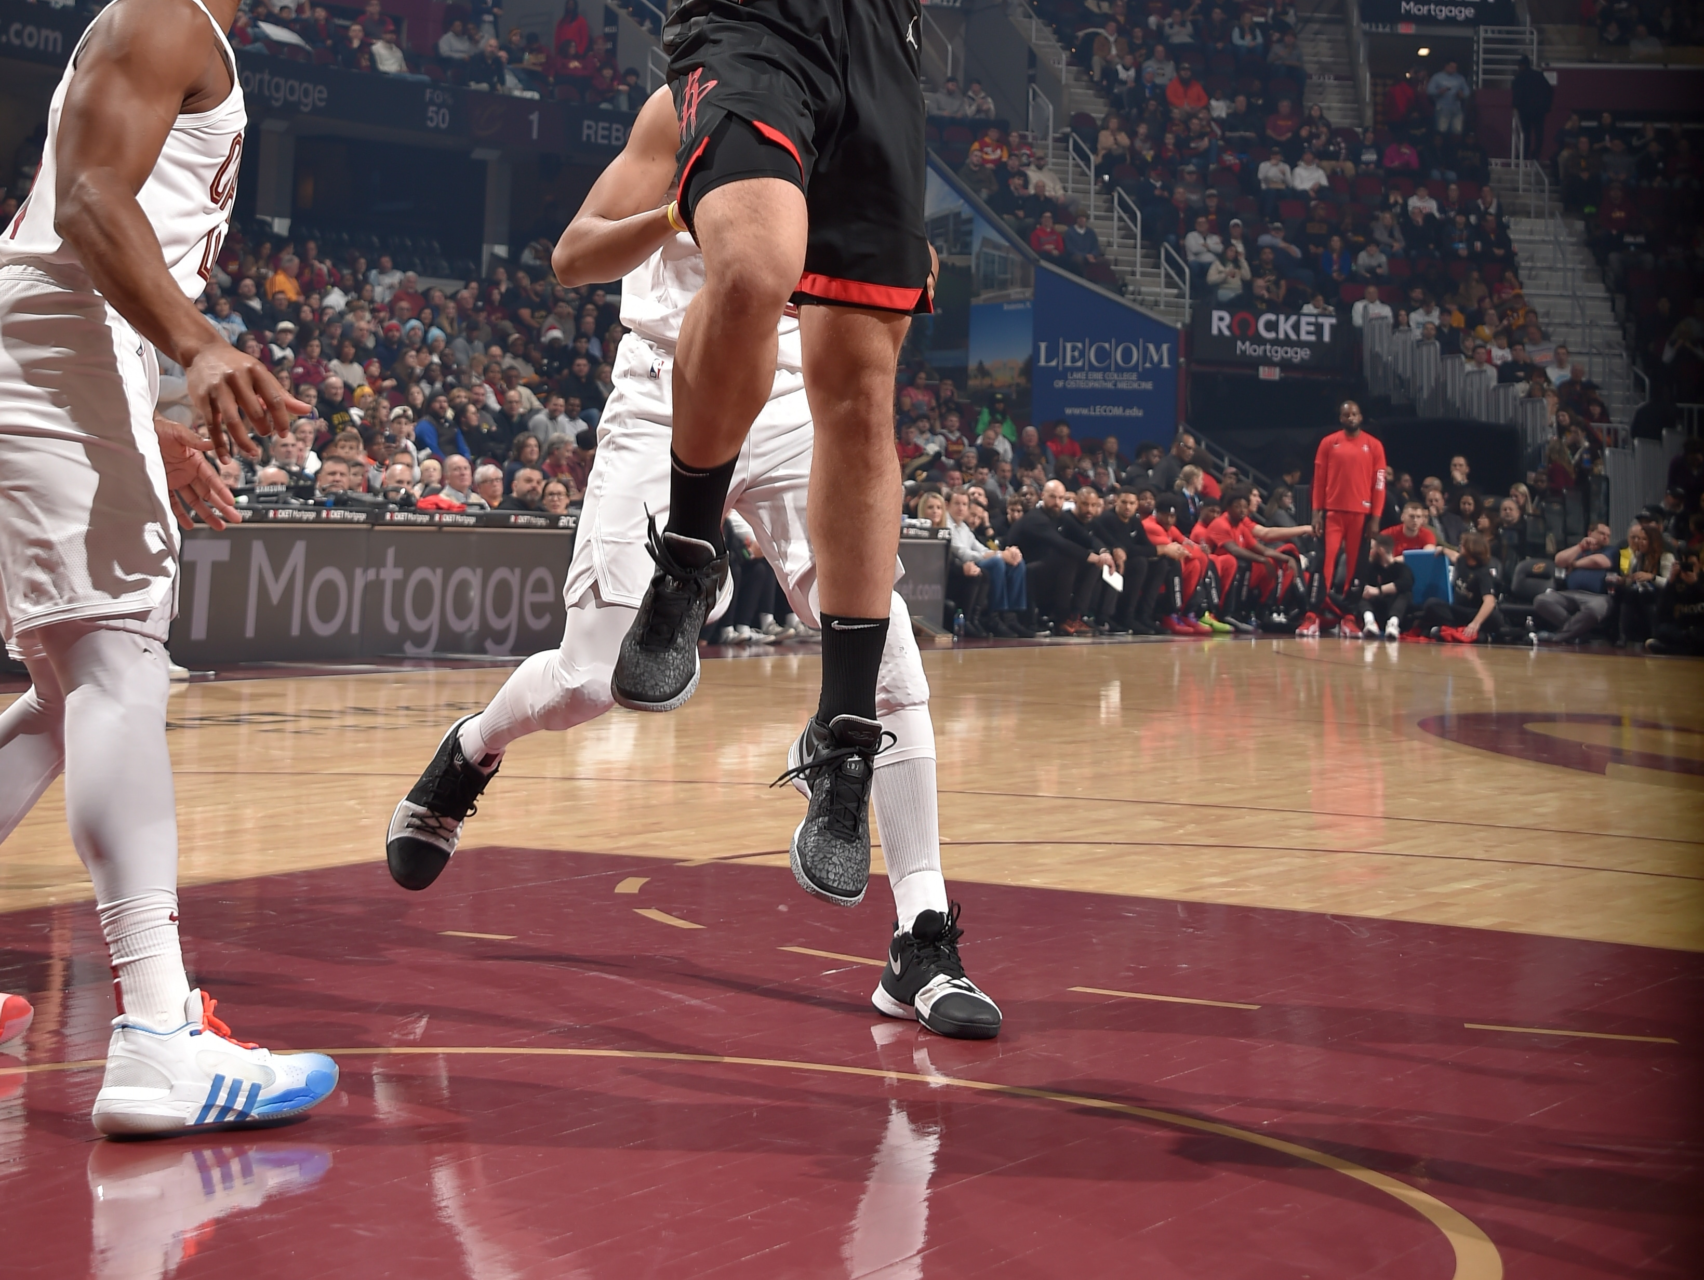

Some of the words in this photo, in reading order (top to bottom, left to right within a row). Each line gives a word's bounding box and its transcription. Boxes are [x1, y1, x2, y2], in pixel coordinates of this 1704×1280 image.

[1400, 0, 1476, 21] Mortgage
[1, 21, 63, 55] .com
[238, 65, 328, 113] ortgage
[424, 88, 454, 106] FG%
[425, 105, 450, 130] 50
[528, 110, 540, 140] 1
[581, 119, 633, 147] REB
[1211, 309, 1338, 344] ROCKET
[1236, 339, 1312, 363] Mortgage
[1067, 371, 1086, 380] LAKE
[1088, 371, 1104, 380] ERIE
[1105, 372, 1138, 380] COLLEGE
[1053, 379, 1064, 389] OF
[1065, 379, 1116, 389] OSTEOPATHIC
[1117, 380, 1153, 390] MEDICINE
[1064, 405, 1144, 417] www.LECOM.edu
[255, 484, 287, 493] SAMSUNG
[268, 508, 292, 519] ROCKET
[321, 509, 344, 519] ROCKET
[385, 511, 407, 521] ROCKET
[434, 513, 455, 523] ROCKET
[183, 539, 231, 641] T
[244, 538, 556, 656] Mortgage
